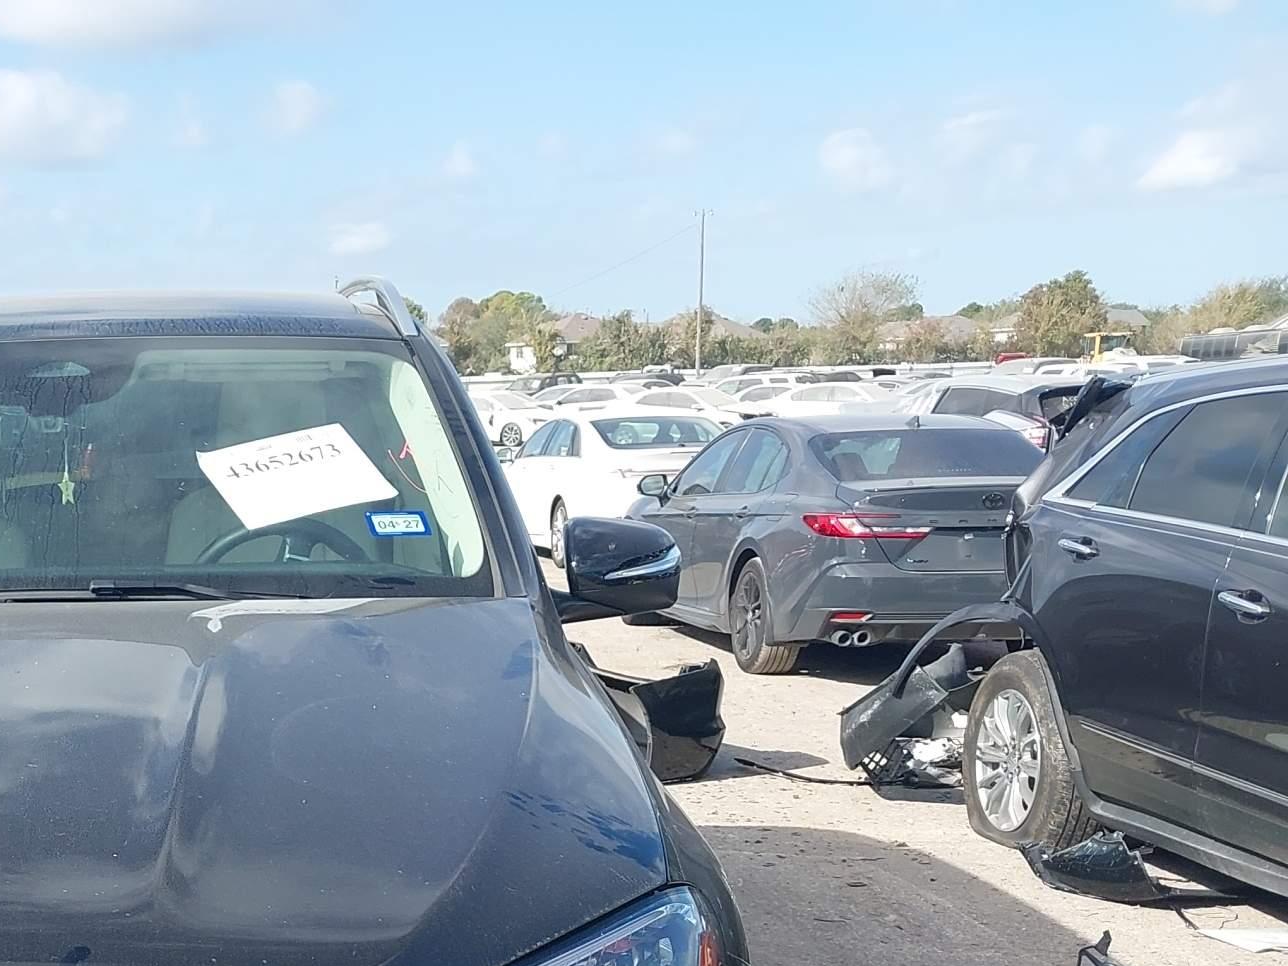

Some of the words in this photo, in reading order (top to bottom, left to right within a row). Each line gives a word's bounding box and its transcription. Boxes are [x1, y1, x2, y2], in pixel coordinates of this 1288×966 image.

[226, 443, 342, 479] 43652673
[377, 520, 396, 530] 04
[403, 519, 420, 529] 27
